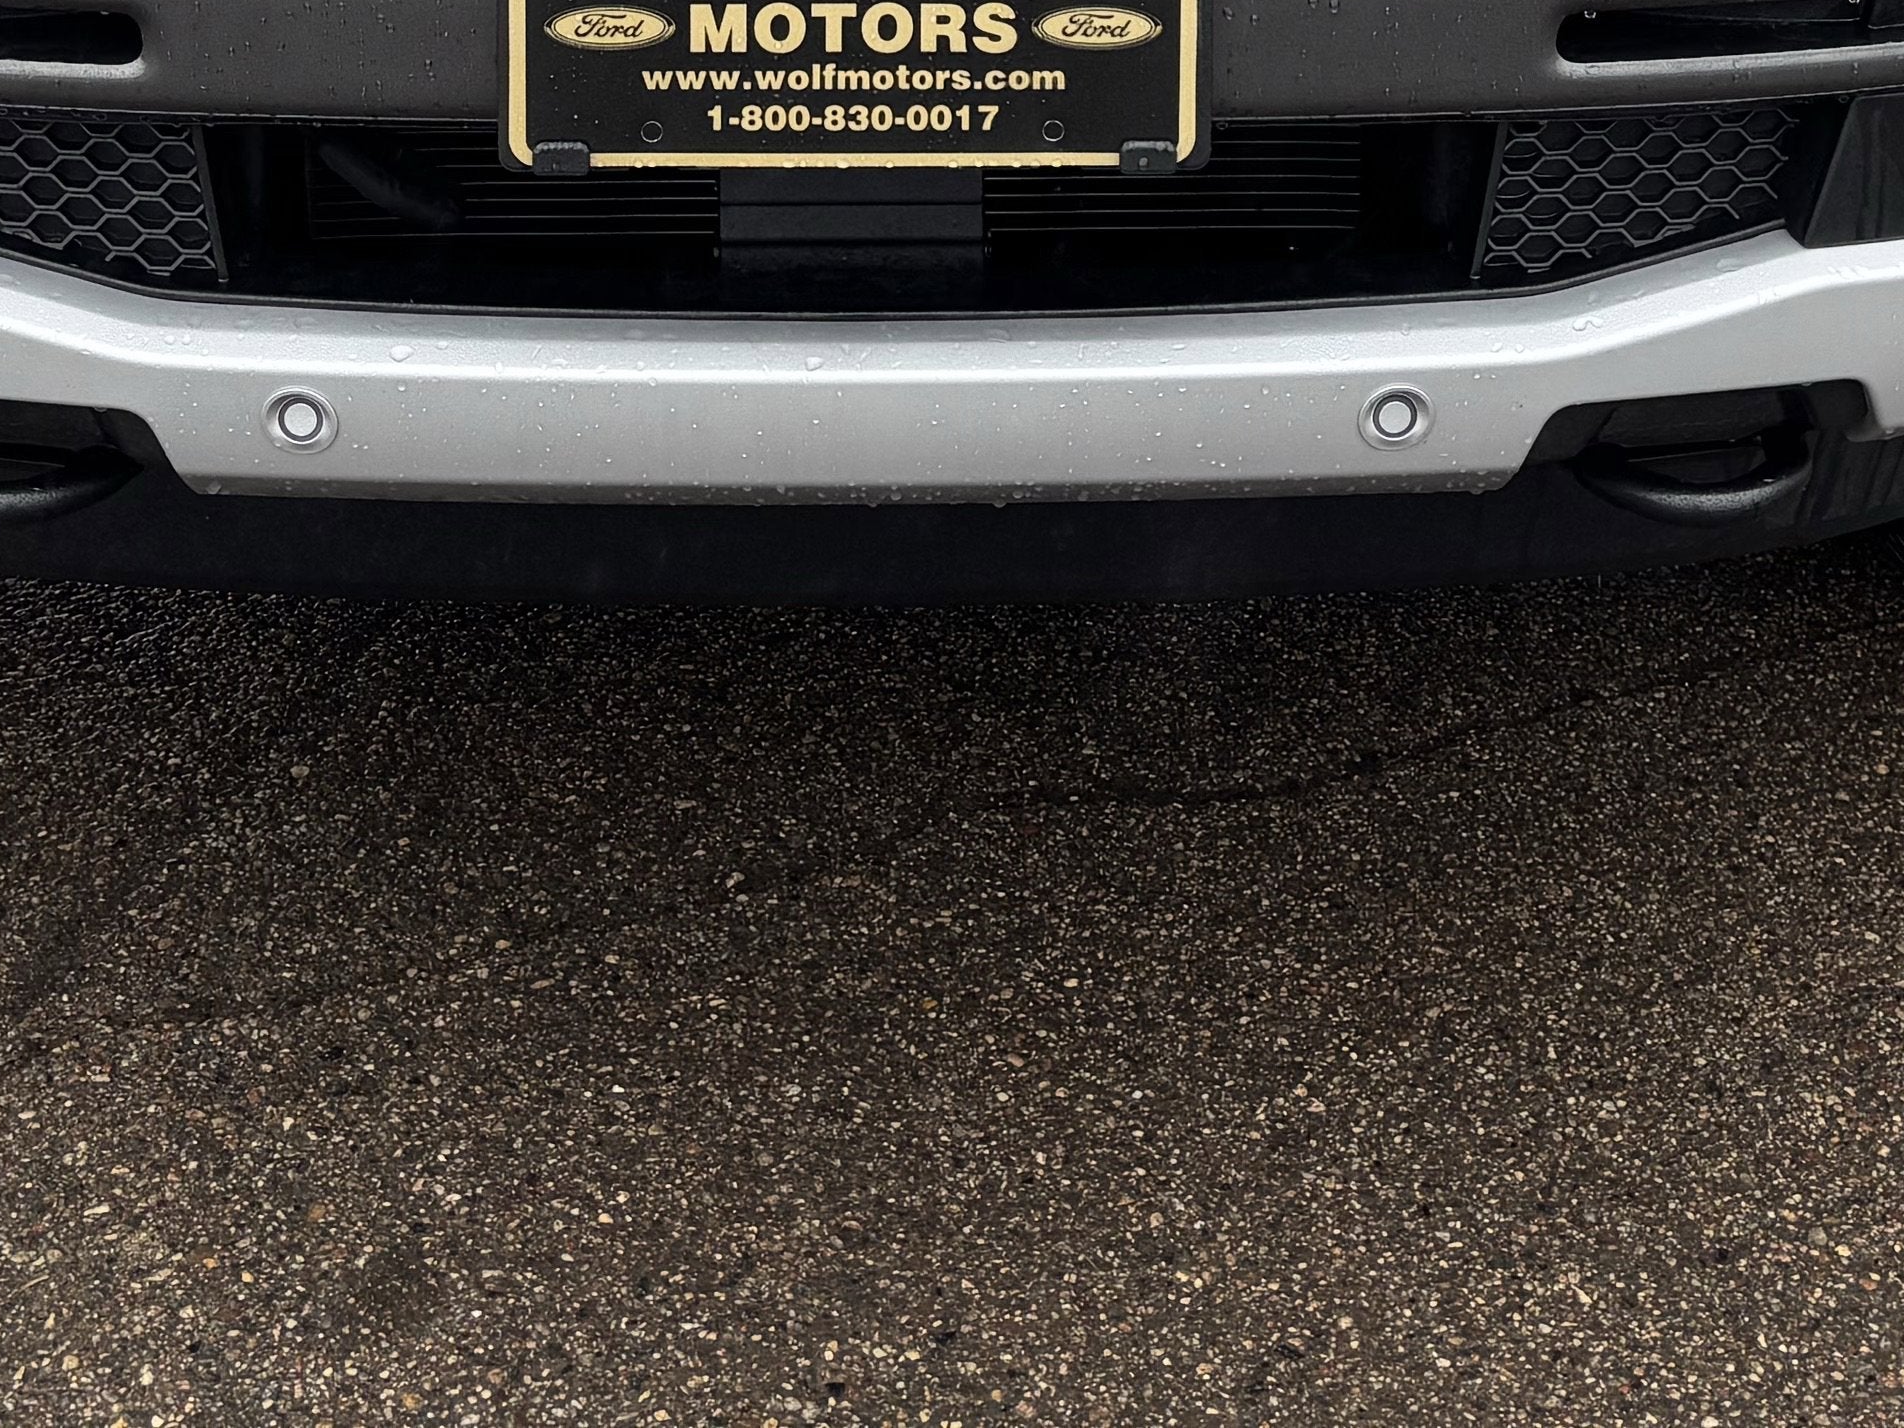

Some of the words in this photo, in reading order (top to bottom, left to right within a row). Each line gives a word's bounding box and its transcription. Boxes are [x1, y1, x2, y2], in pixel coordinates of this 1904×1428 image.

[571, 6, 646, 41] Ford
[688, 2, 1019, 55] MOTORS
[1059, 6, 1133, 41] Ford
[641, 64, 1067, 93] www.wolfmotors.com
[706, 104, 1000, 133] 1-800-830-0017
